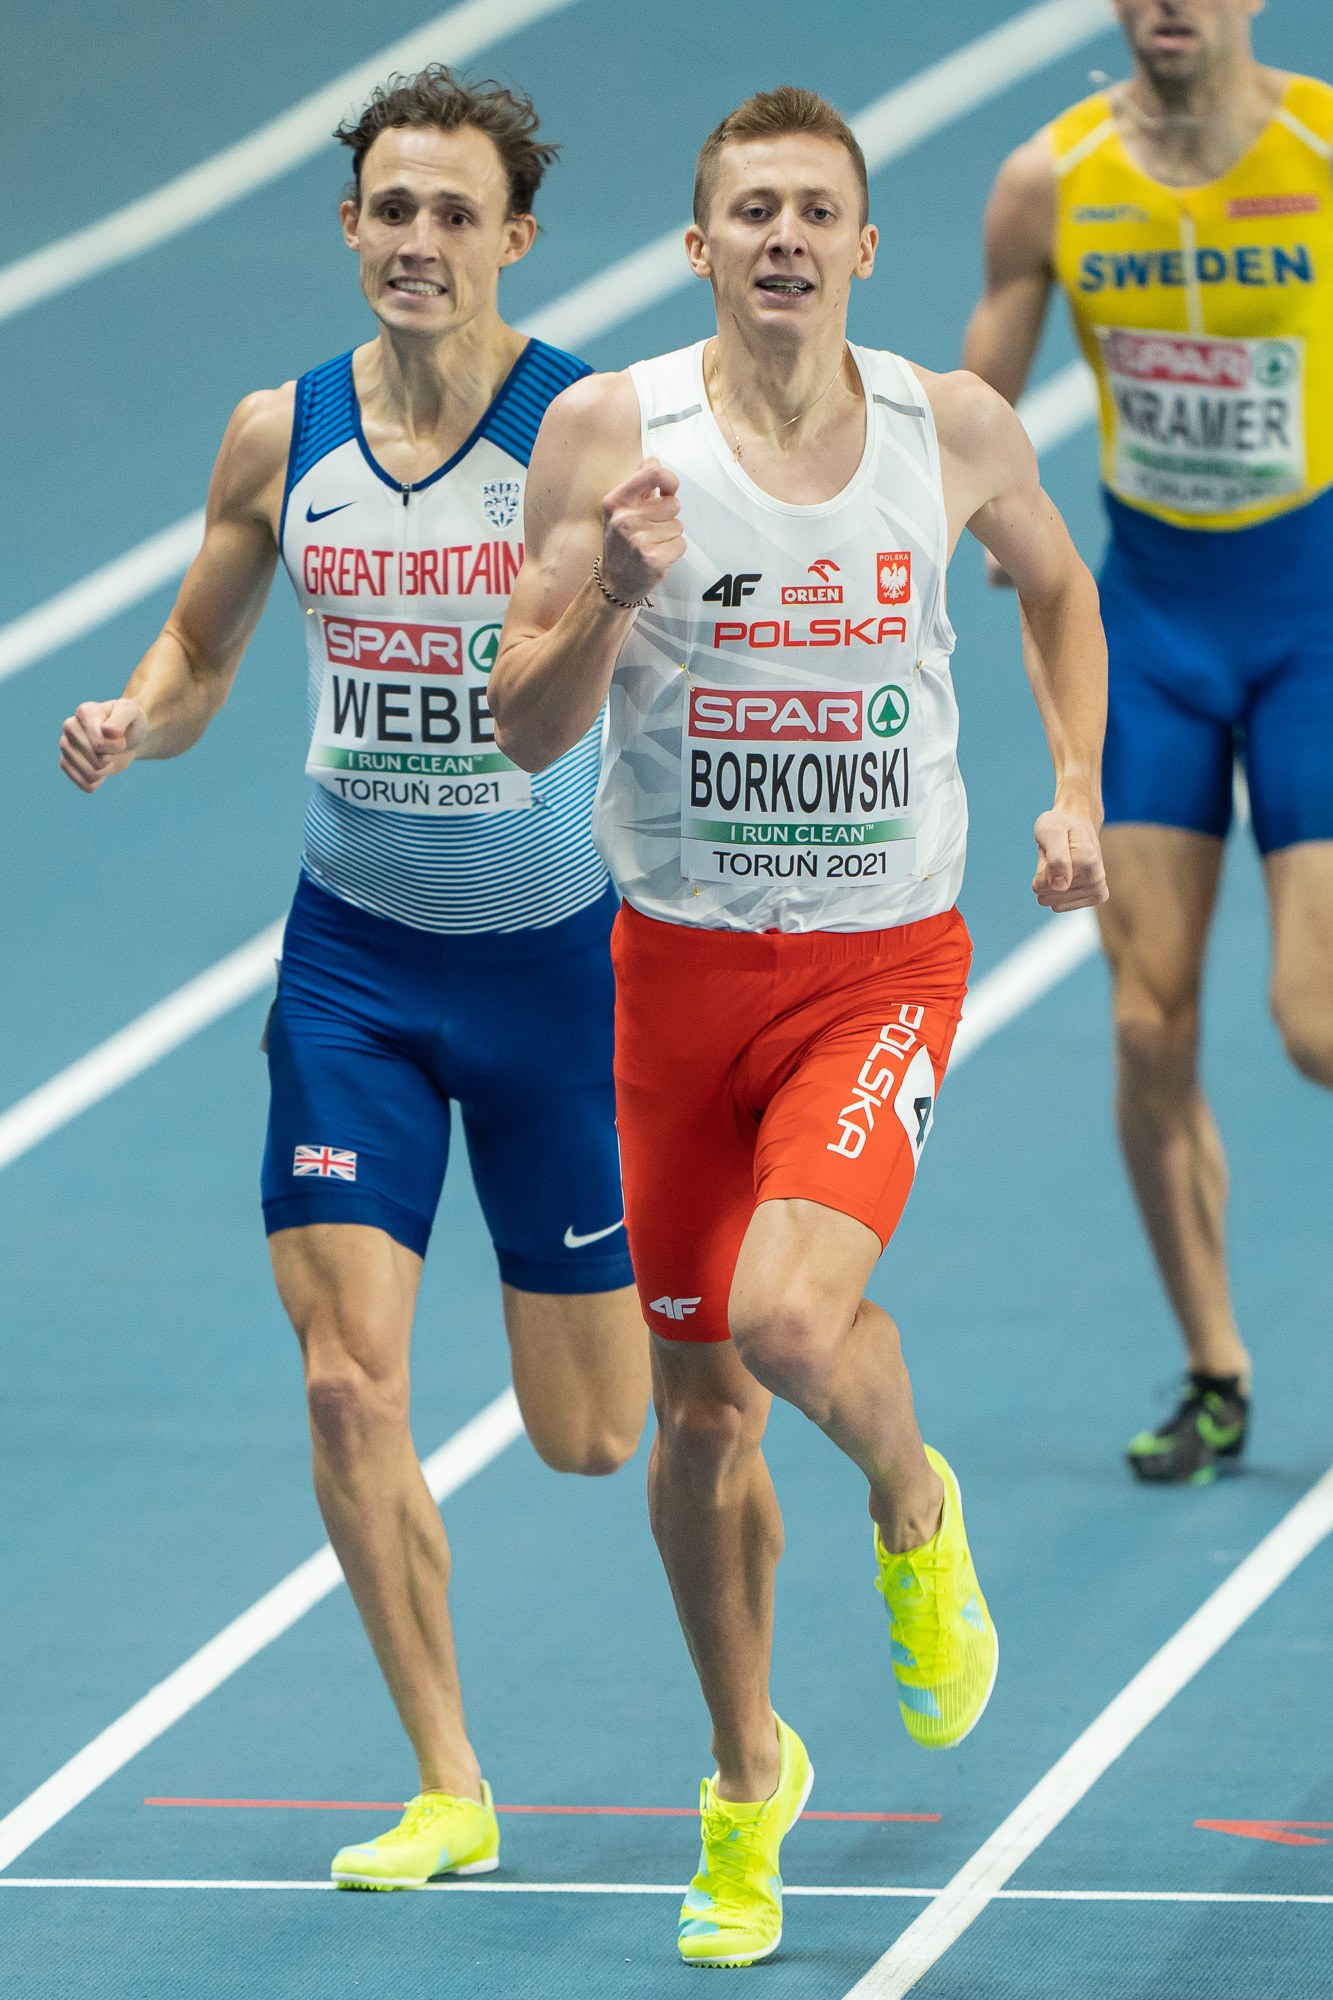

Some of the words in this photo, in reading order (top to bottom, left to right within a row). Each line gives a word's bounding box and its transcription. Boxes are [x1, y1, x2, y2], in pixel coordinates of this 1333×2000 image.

[1081, 246, 1313, 291] SWEDEN
[304, 545, 393, 596] GREAT
[399, 541, 524, 595] BRITAIN
[879, 553, 909, 562] POLSKA
[702, 573, 762, 607] 4F
[784, 587, 839, 603] ORLEN
[327, 623, 458, 667] SPAR
[714, 616, 906, 648] POLSKA
[694, 697, 858, 734] SPAR
[349, 752, 355, 766] I
[359, 754, 402, 771] RUN
[334, 778, 430, 806] TORUŃ
[437, 781, 500, 807] 2021
[690, 747, 909, 814] BORKOWSKI
[731, 824, 736, 841] I
[742, 824, 790, 843] RUN
[712, 850, 818, 878] TORUŃ
[826, 851, 887, 878] 2021
[826, 1003, 924, 1159] POLSKA
[649, 1296, 702, 1320] 4F
